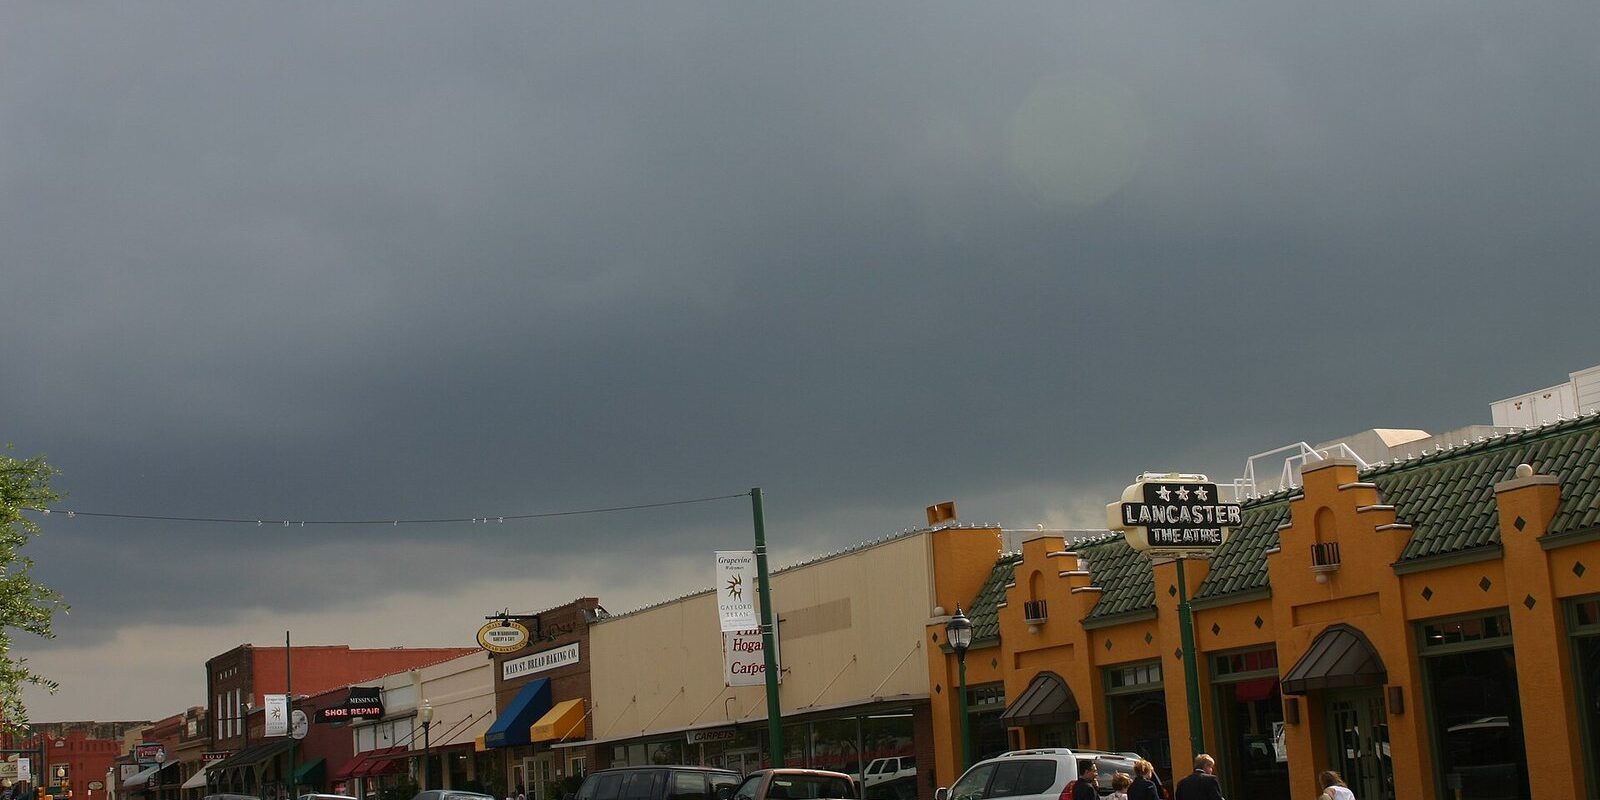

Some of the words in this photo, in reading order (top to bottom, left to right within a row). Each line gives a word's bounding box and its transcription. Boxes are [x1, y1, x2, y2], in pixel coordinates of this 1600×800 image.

[1125, 504, 1242, 525] LANCASTER
[1151, 528, 1221, 543] THEATRE
[717, 556, 752, 566] Grapevine
[720, 603, 753, 612] GAYLORD
[505, 663, 518, 675] MAIN
[527, 656, 545, 670] BREAD
[545, 650, 567, 665] BAKING
[567, 648, 577, 659] CO.
[350, 707, 380, 715] REPAIR
[694, 729, 734, 740] CARPETS
